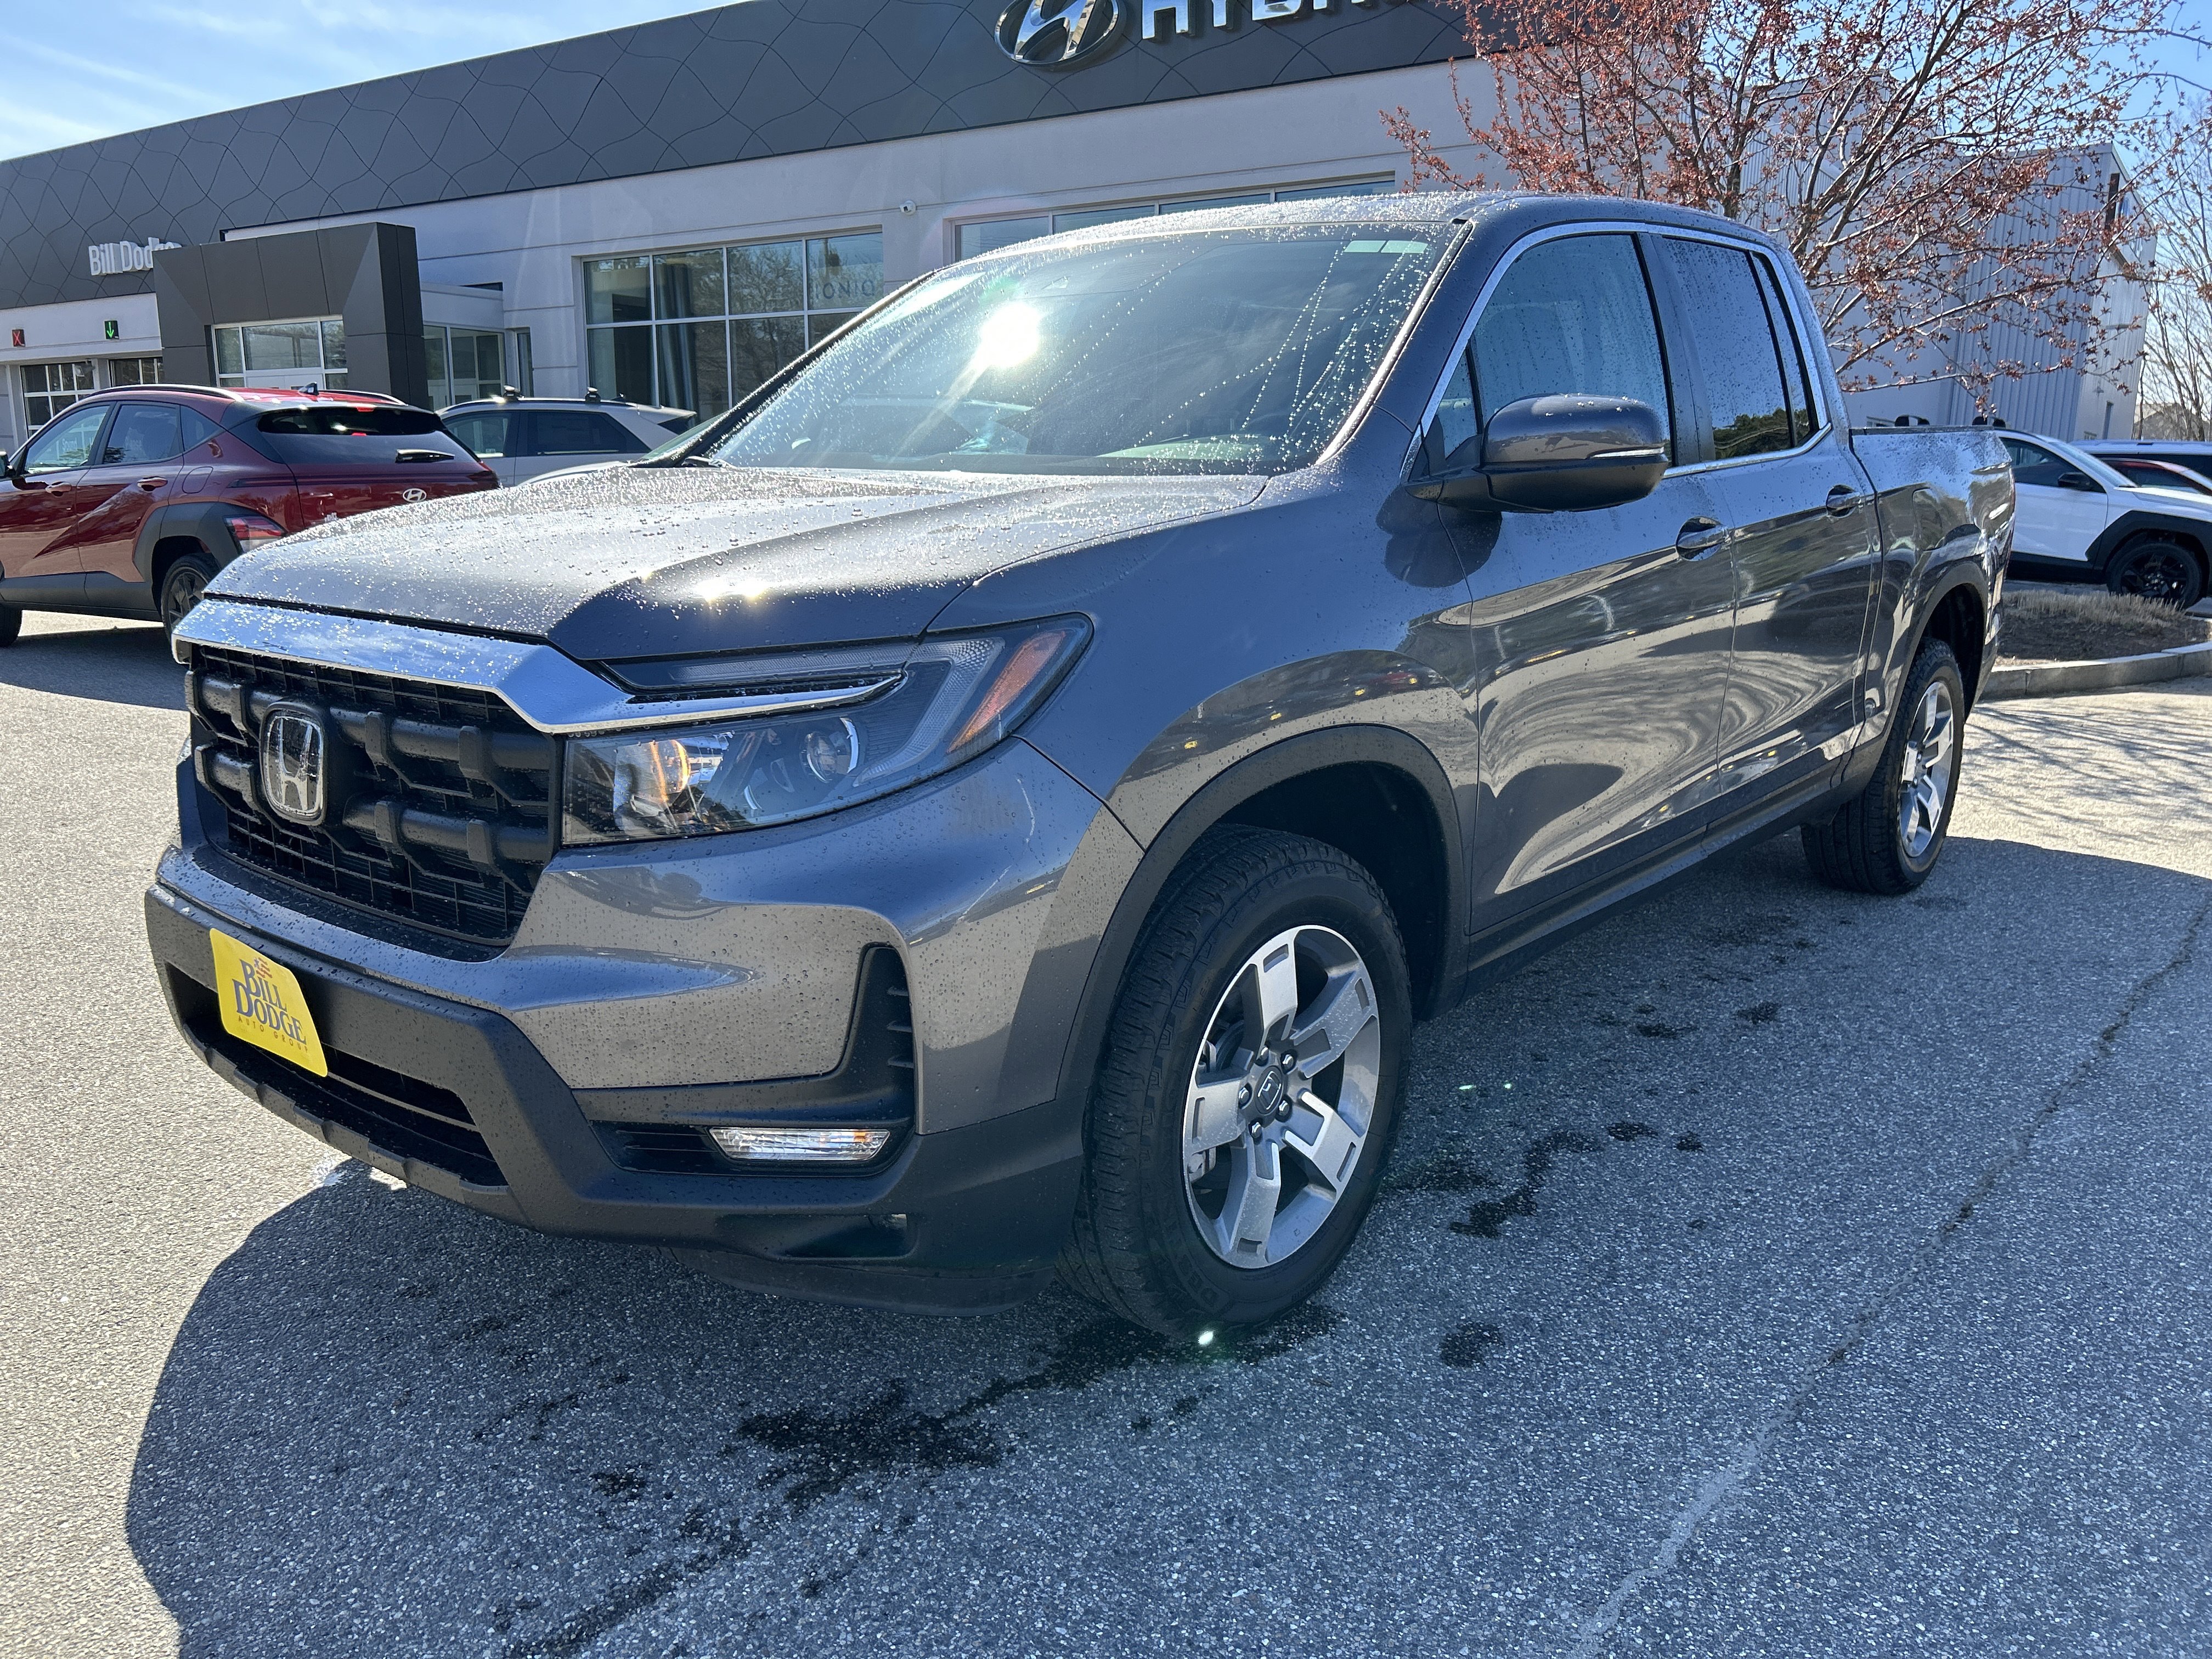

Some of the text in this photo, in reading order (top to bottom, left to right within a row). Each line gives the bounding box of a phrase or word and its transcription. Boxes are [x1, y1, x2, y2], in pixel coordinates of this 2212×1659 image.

[88, 236, 182, 275] Bill Dod
[815, 279, 876, 300] IONIQ
[239, 959, 287, 1013] BILL
[232, 978, 307, 1046] DODGE
[238, 1015, 308, 1053] AUTO GROUP
